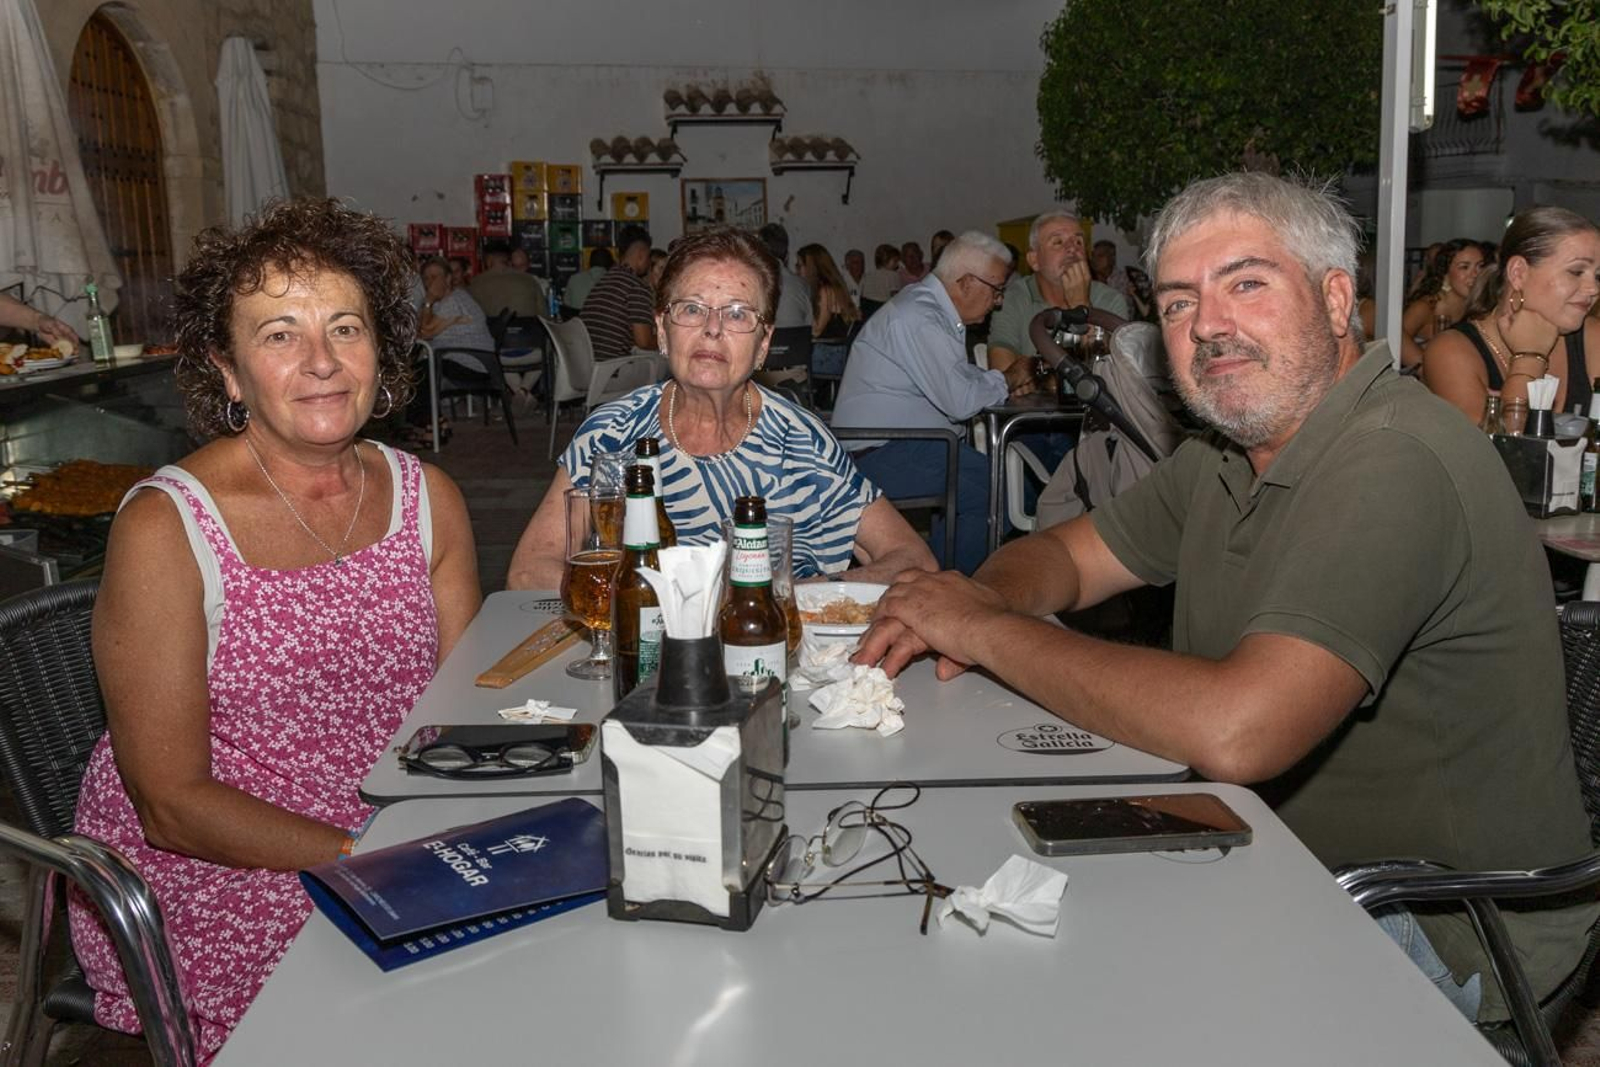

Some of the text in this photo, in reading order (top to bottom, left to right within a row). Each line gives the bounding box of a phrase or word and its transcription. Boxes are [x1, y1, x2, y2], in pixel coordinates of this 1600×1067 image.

[1015, 732, 1092, 741] Estrella
[1022, 739, 1094, 748] Galicia
[433, 847, 489, 887] HOGAR
